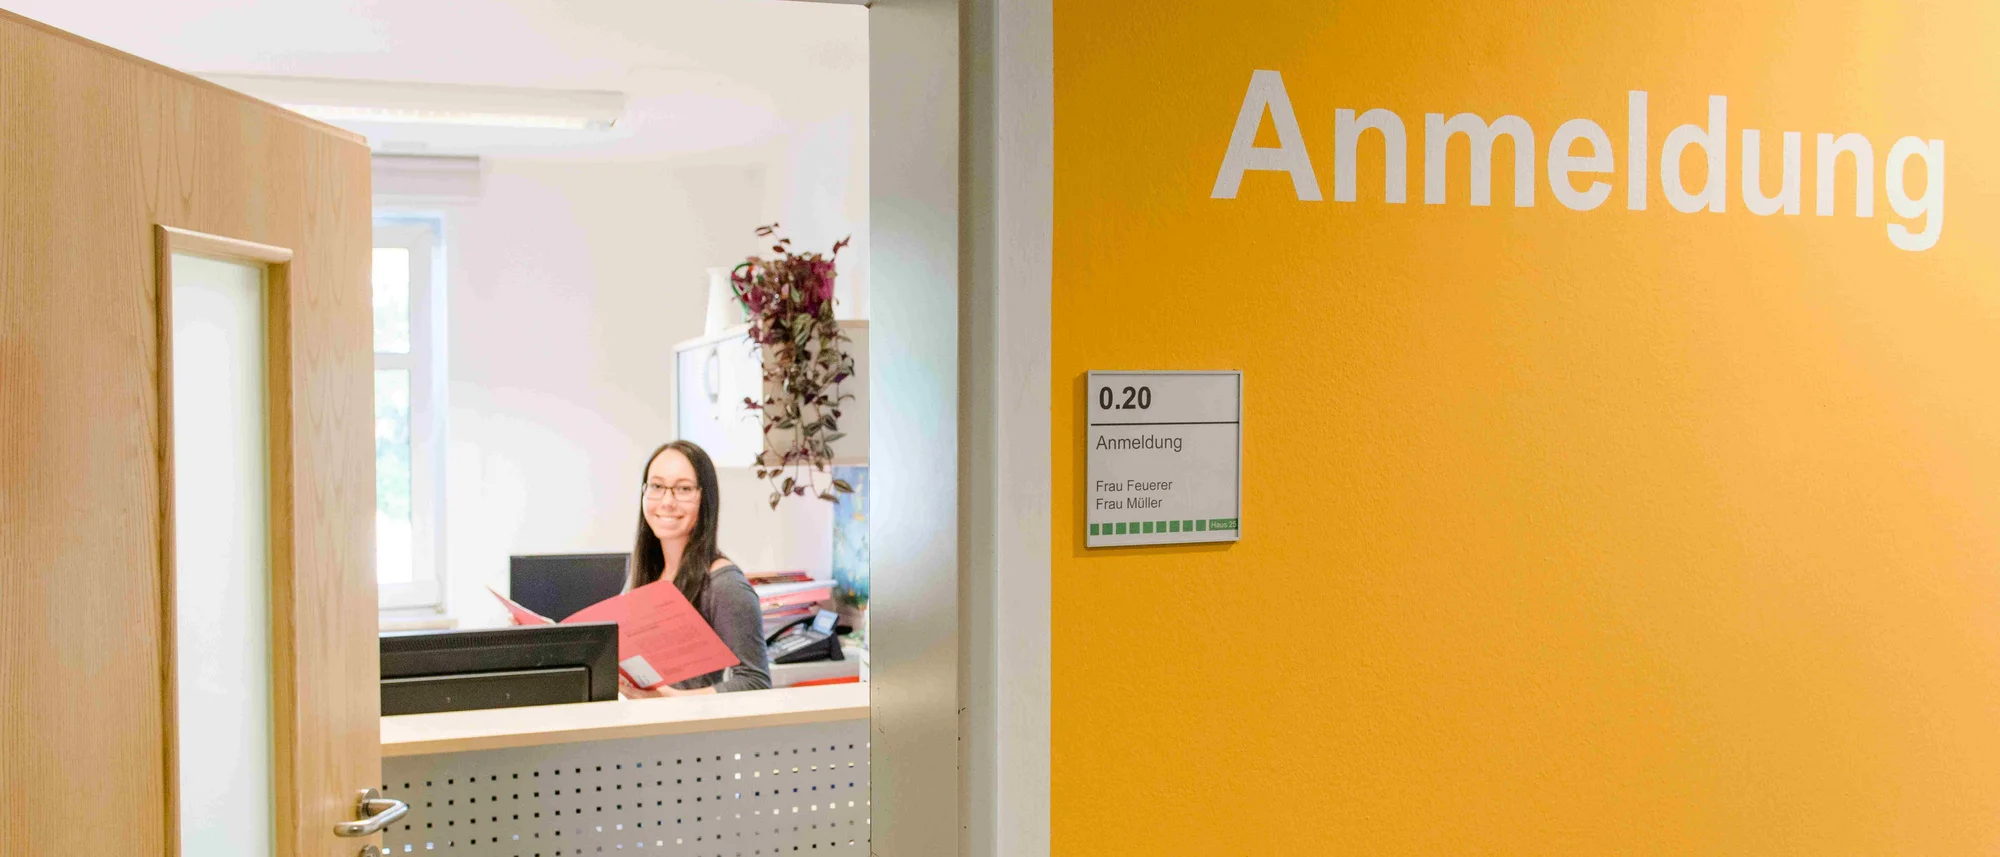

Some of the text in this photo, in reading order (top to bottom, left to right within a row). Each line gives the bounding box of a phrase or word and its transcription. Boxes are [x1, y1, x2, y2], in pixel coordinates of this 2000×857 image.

[1210, 69, 1946, 252] Anmeldung
[1099, 386, 1152, 410] 0.20
[1096, 434, 1183, 453] Anmeldung
[1096, 479, 1173, 492] Frau Feuerer
[1096, 497, 1163, 510] Frau Müller
[1210, 520, 1237, 529] Haus 25
